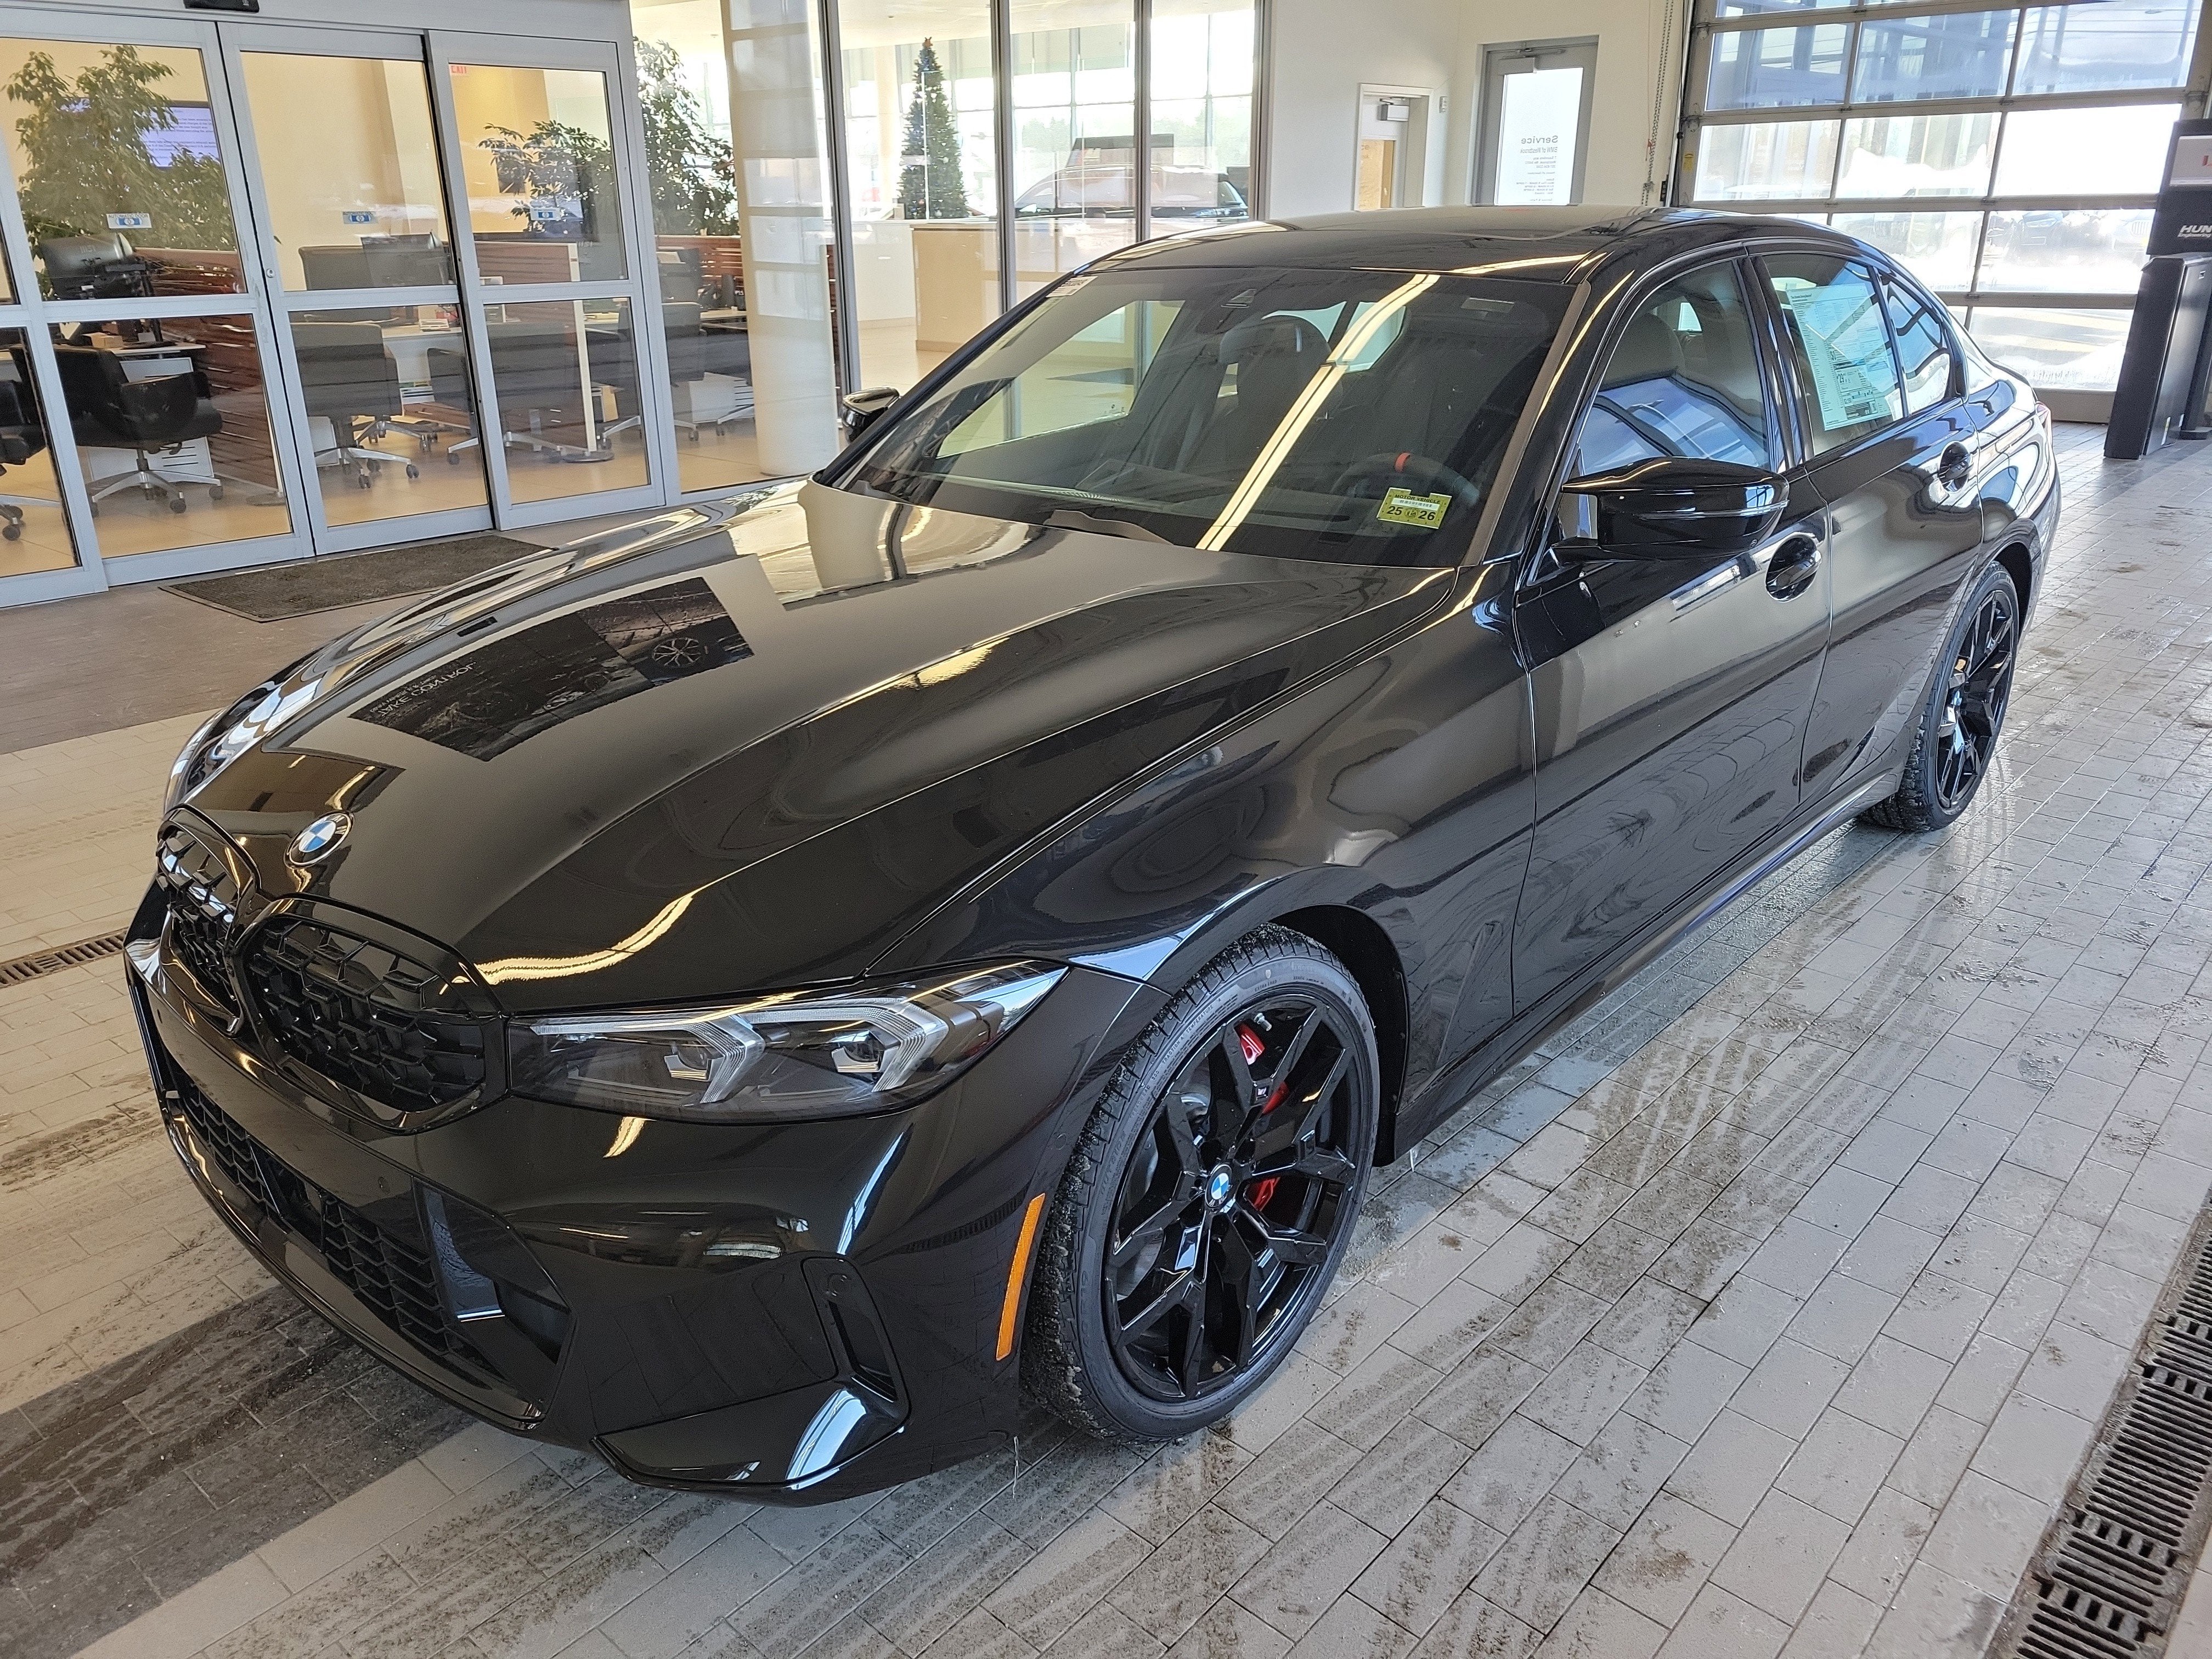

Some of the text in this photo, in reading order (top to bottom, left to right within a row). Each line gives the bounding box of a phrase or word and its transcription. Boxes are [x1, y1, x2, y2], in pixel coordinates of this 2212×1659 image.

[1386, 506, 1436, 521] 25 26
[1162, 1040, 1180, 1064] TRACTION
[1186, 1005, 1214, 1034] TEMPERATURE
